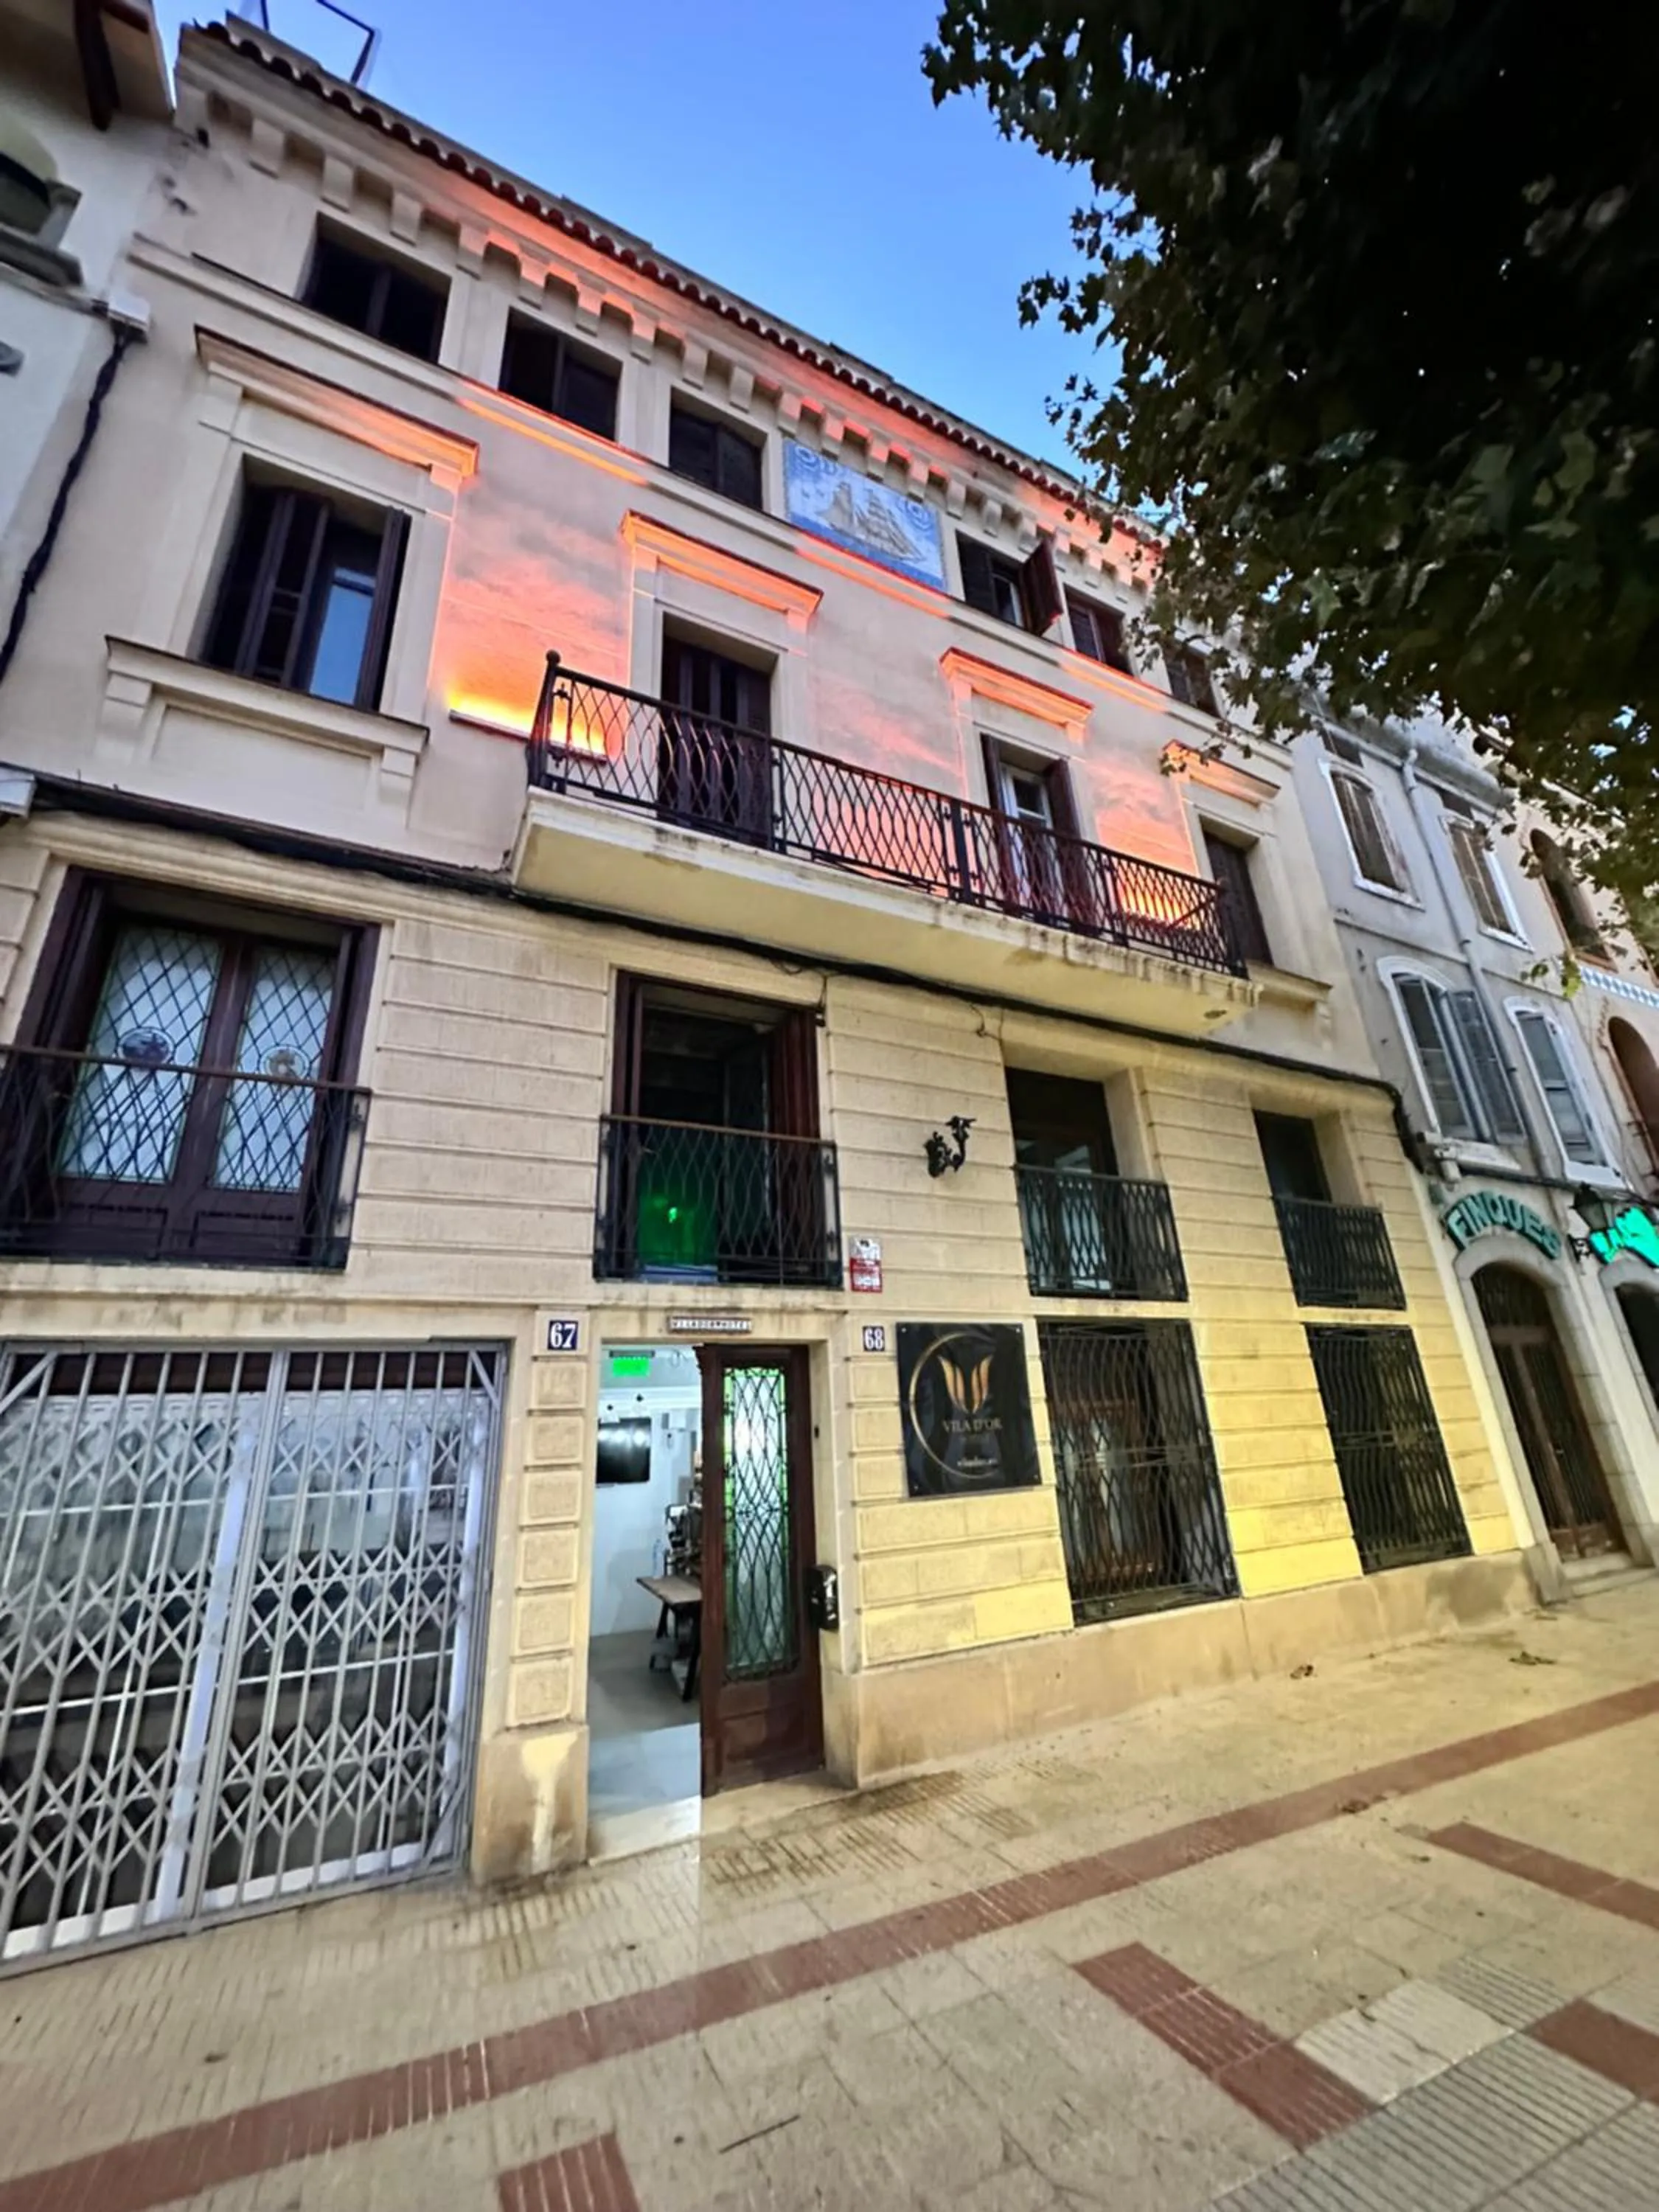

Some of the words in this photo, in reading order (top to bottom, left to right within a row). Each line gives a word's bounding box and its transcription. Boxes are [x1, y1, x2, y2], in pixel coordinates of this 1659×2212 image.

[1444, 1190, 1562, 1259] FINQUES
[550, 1322, 576, 1348] 67
[864, 1328, 883, 1349] 68
[942, 1419, 972, 1433] VILA
